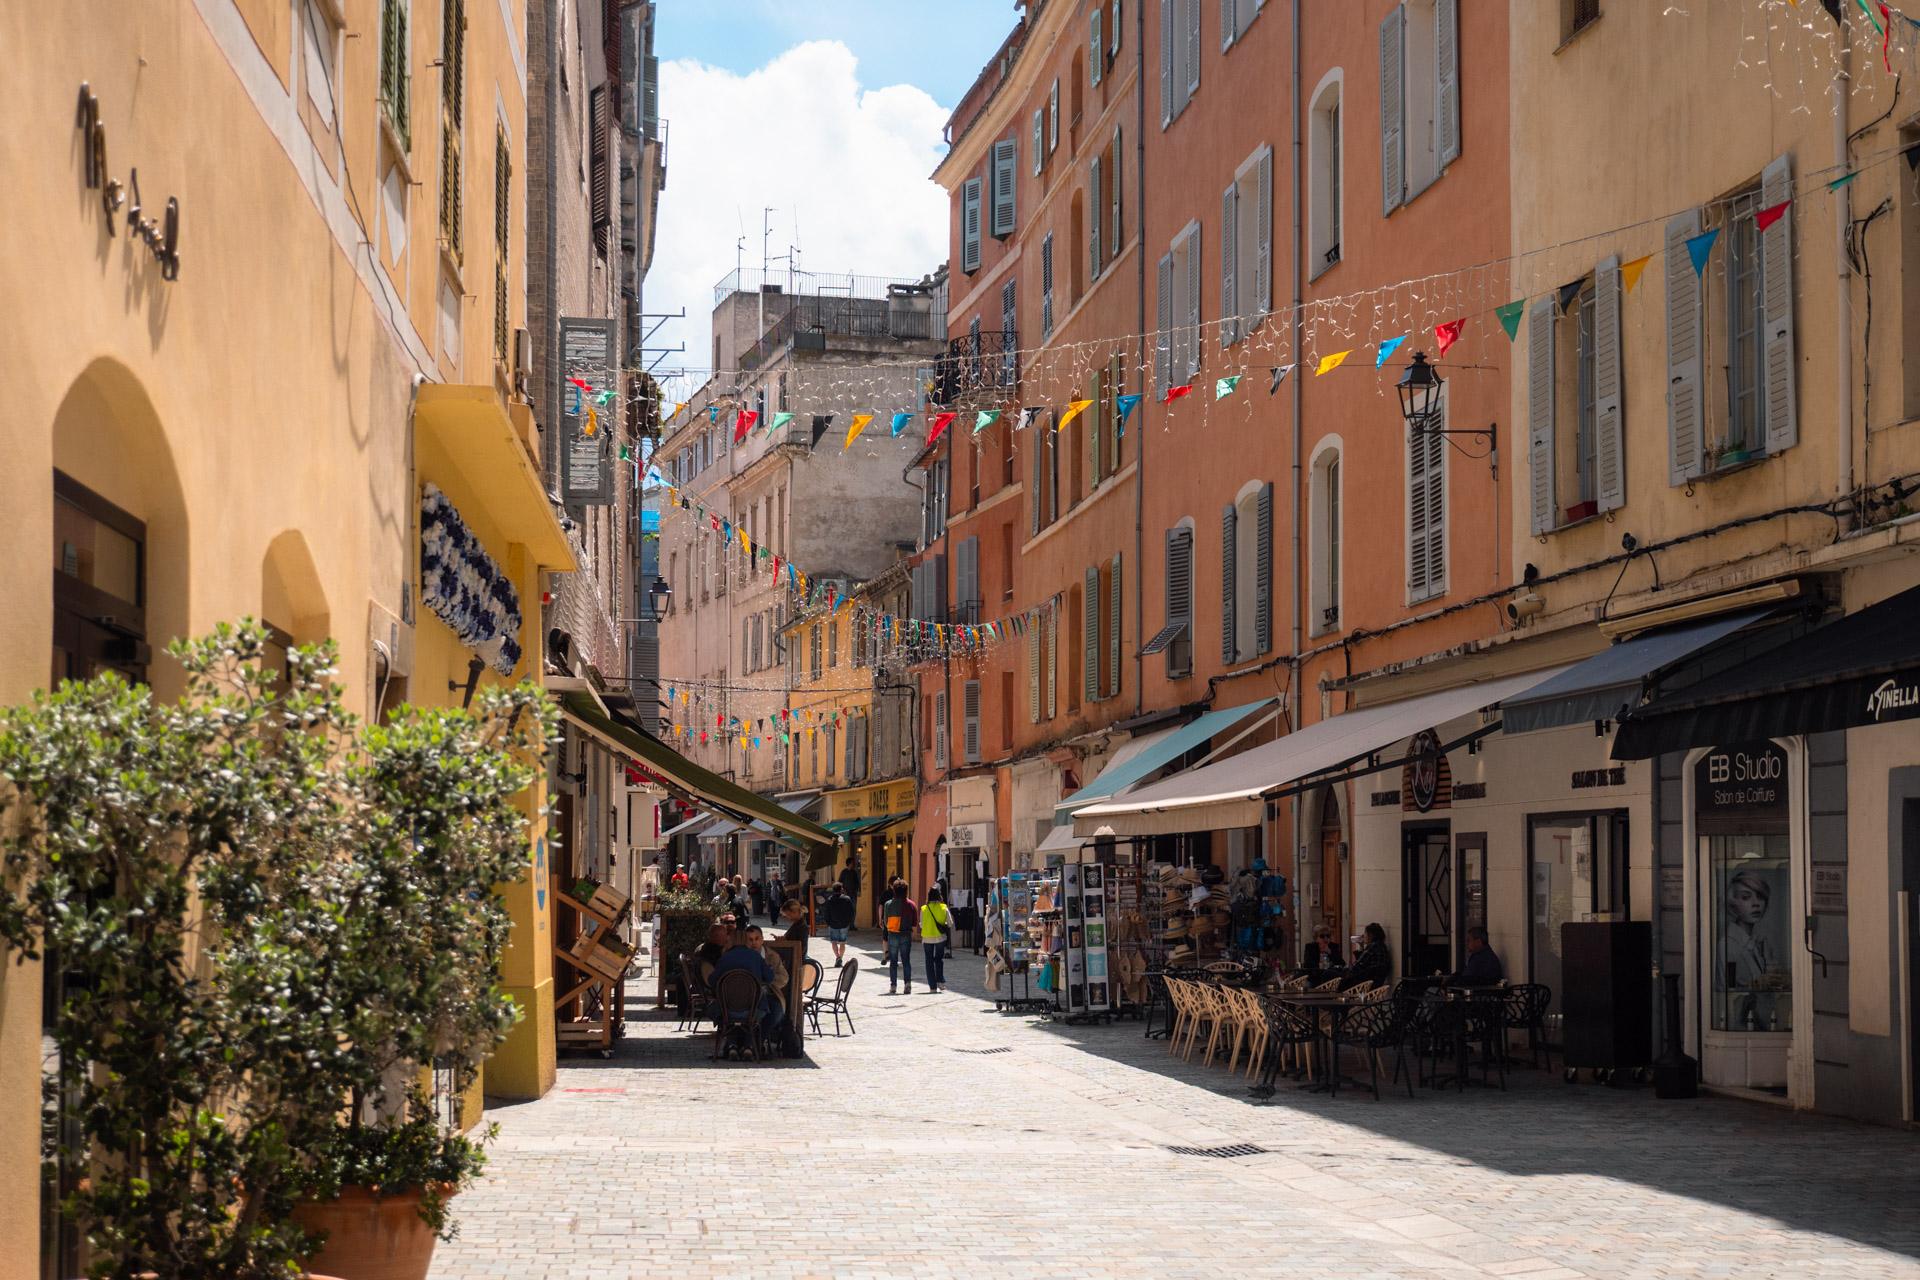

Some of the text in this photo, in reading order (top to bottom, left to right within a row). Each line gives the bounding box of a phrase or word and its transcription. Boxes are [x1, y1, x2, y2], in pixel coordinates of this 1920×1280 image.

[1709, 749, 1781, 783] EB Studio
[1714, 787, 1776, 805] Salon de Coiffure
